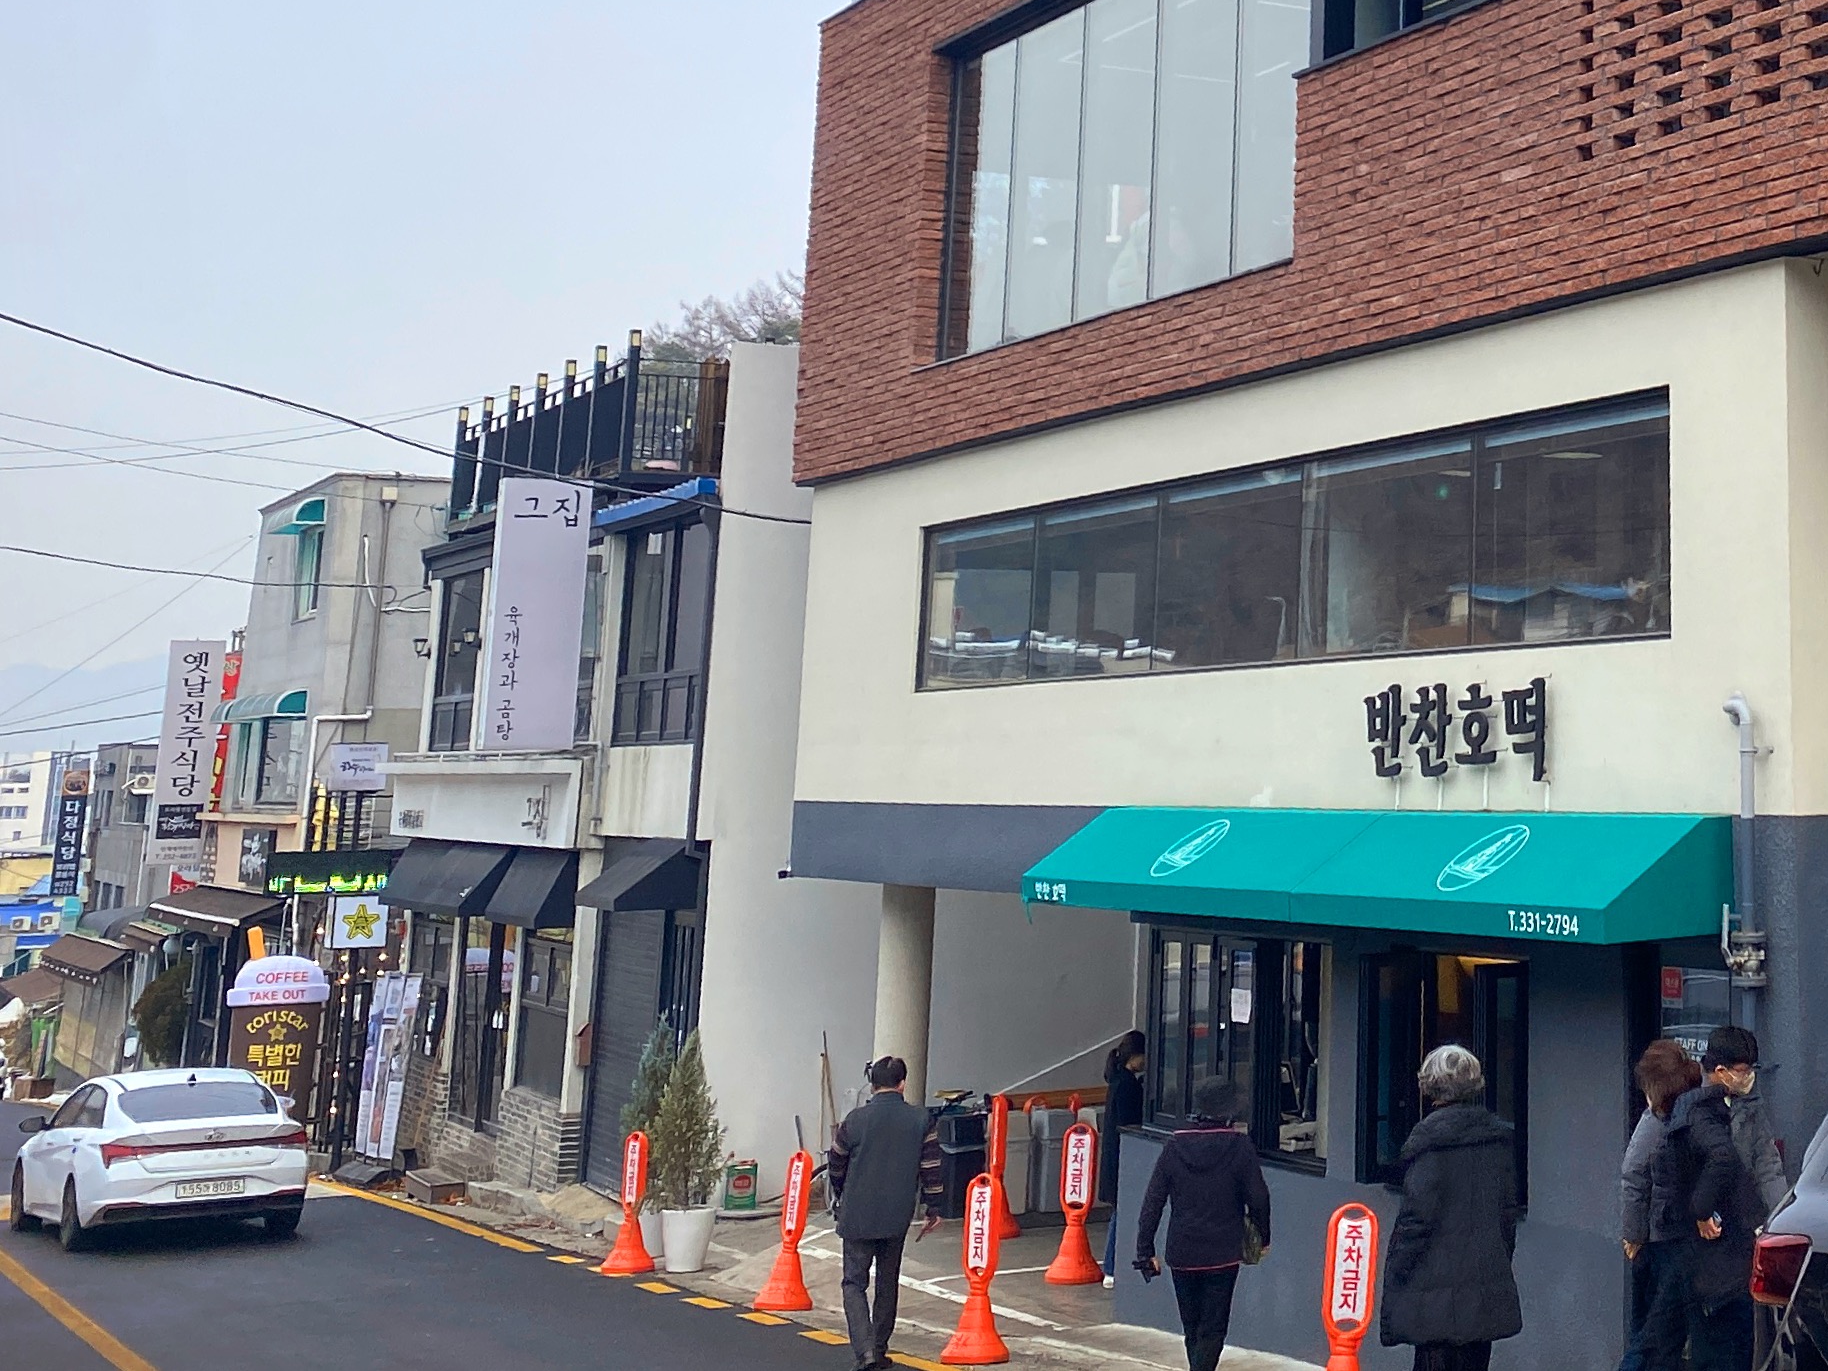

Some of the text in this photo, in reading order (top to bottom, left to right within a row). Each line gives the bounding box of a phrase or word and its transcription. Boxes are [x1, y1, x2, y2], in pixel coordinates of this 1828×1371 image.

[496, 606, 523, 741] 육개장과 곰탕
[171, 651, 211, 797] 옛날전주식당
[1363, 677, 1546, 782] 반찬호떡
[61, 801, 81, 860] 다정식당
[1507, 910, 1579, 937] T.331-2794
[249, 990, 306, 1002] TAKE OUT
[256, 971, 309, 985] COFFEE
[247, 1043, 302, 1067] 특별한
[1069, 1138, 1086, 1199] 주차금지
[972, 1191, 987, 1262] 주차금지
[1338, 1224, 1364, 1314] 주차금지
